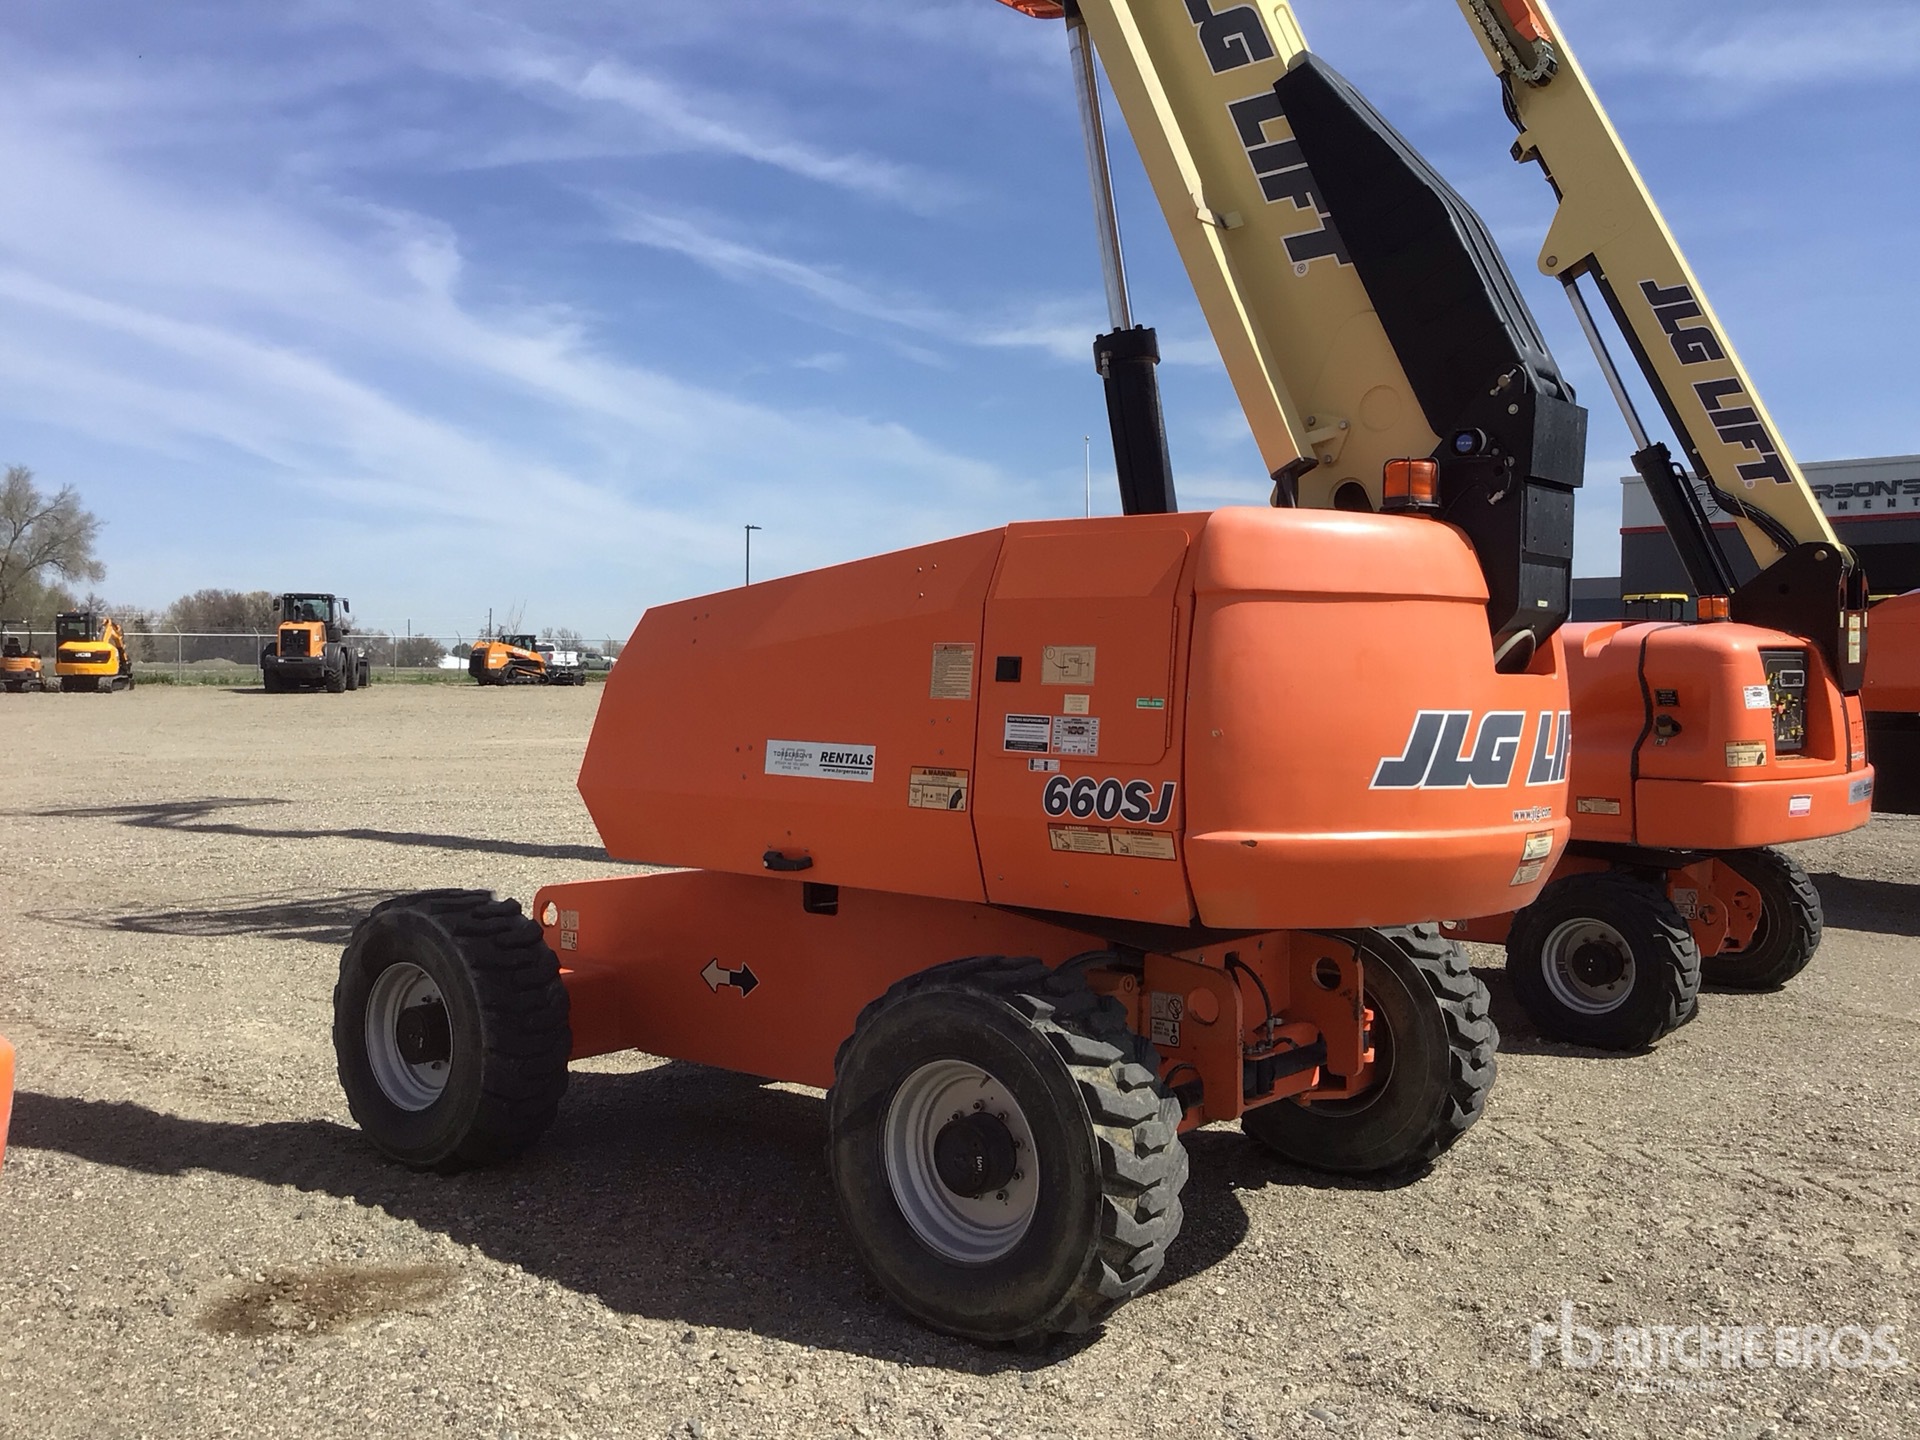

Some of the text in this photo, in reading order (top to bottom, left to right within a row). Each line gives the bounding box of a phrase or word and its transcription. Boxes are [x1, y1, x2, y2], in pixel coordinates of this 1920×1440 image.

[1225, 90, 1355, 268] LIFT
[1637, 278, 1793, 485] JLG LIFT
[1819, 496, 1920, 511] MENT
[820, 751, 874, 766] RENTALS
[823, 767, 869, 776] www.torgerson.biz
[1369, 710, 1526, 790] JLG
[1043, 774, 1177, 825] 660SJ
